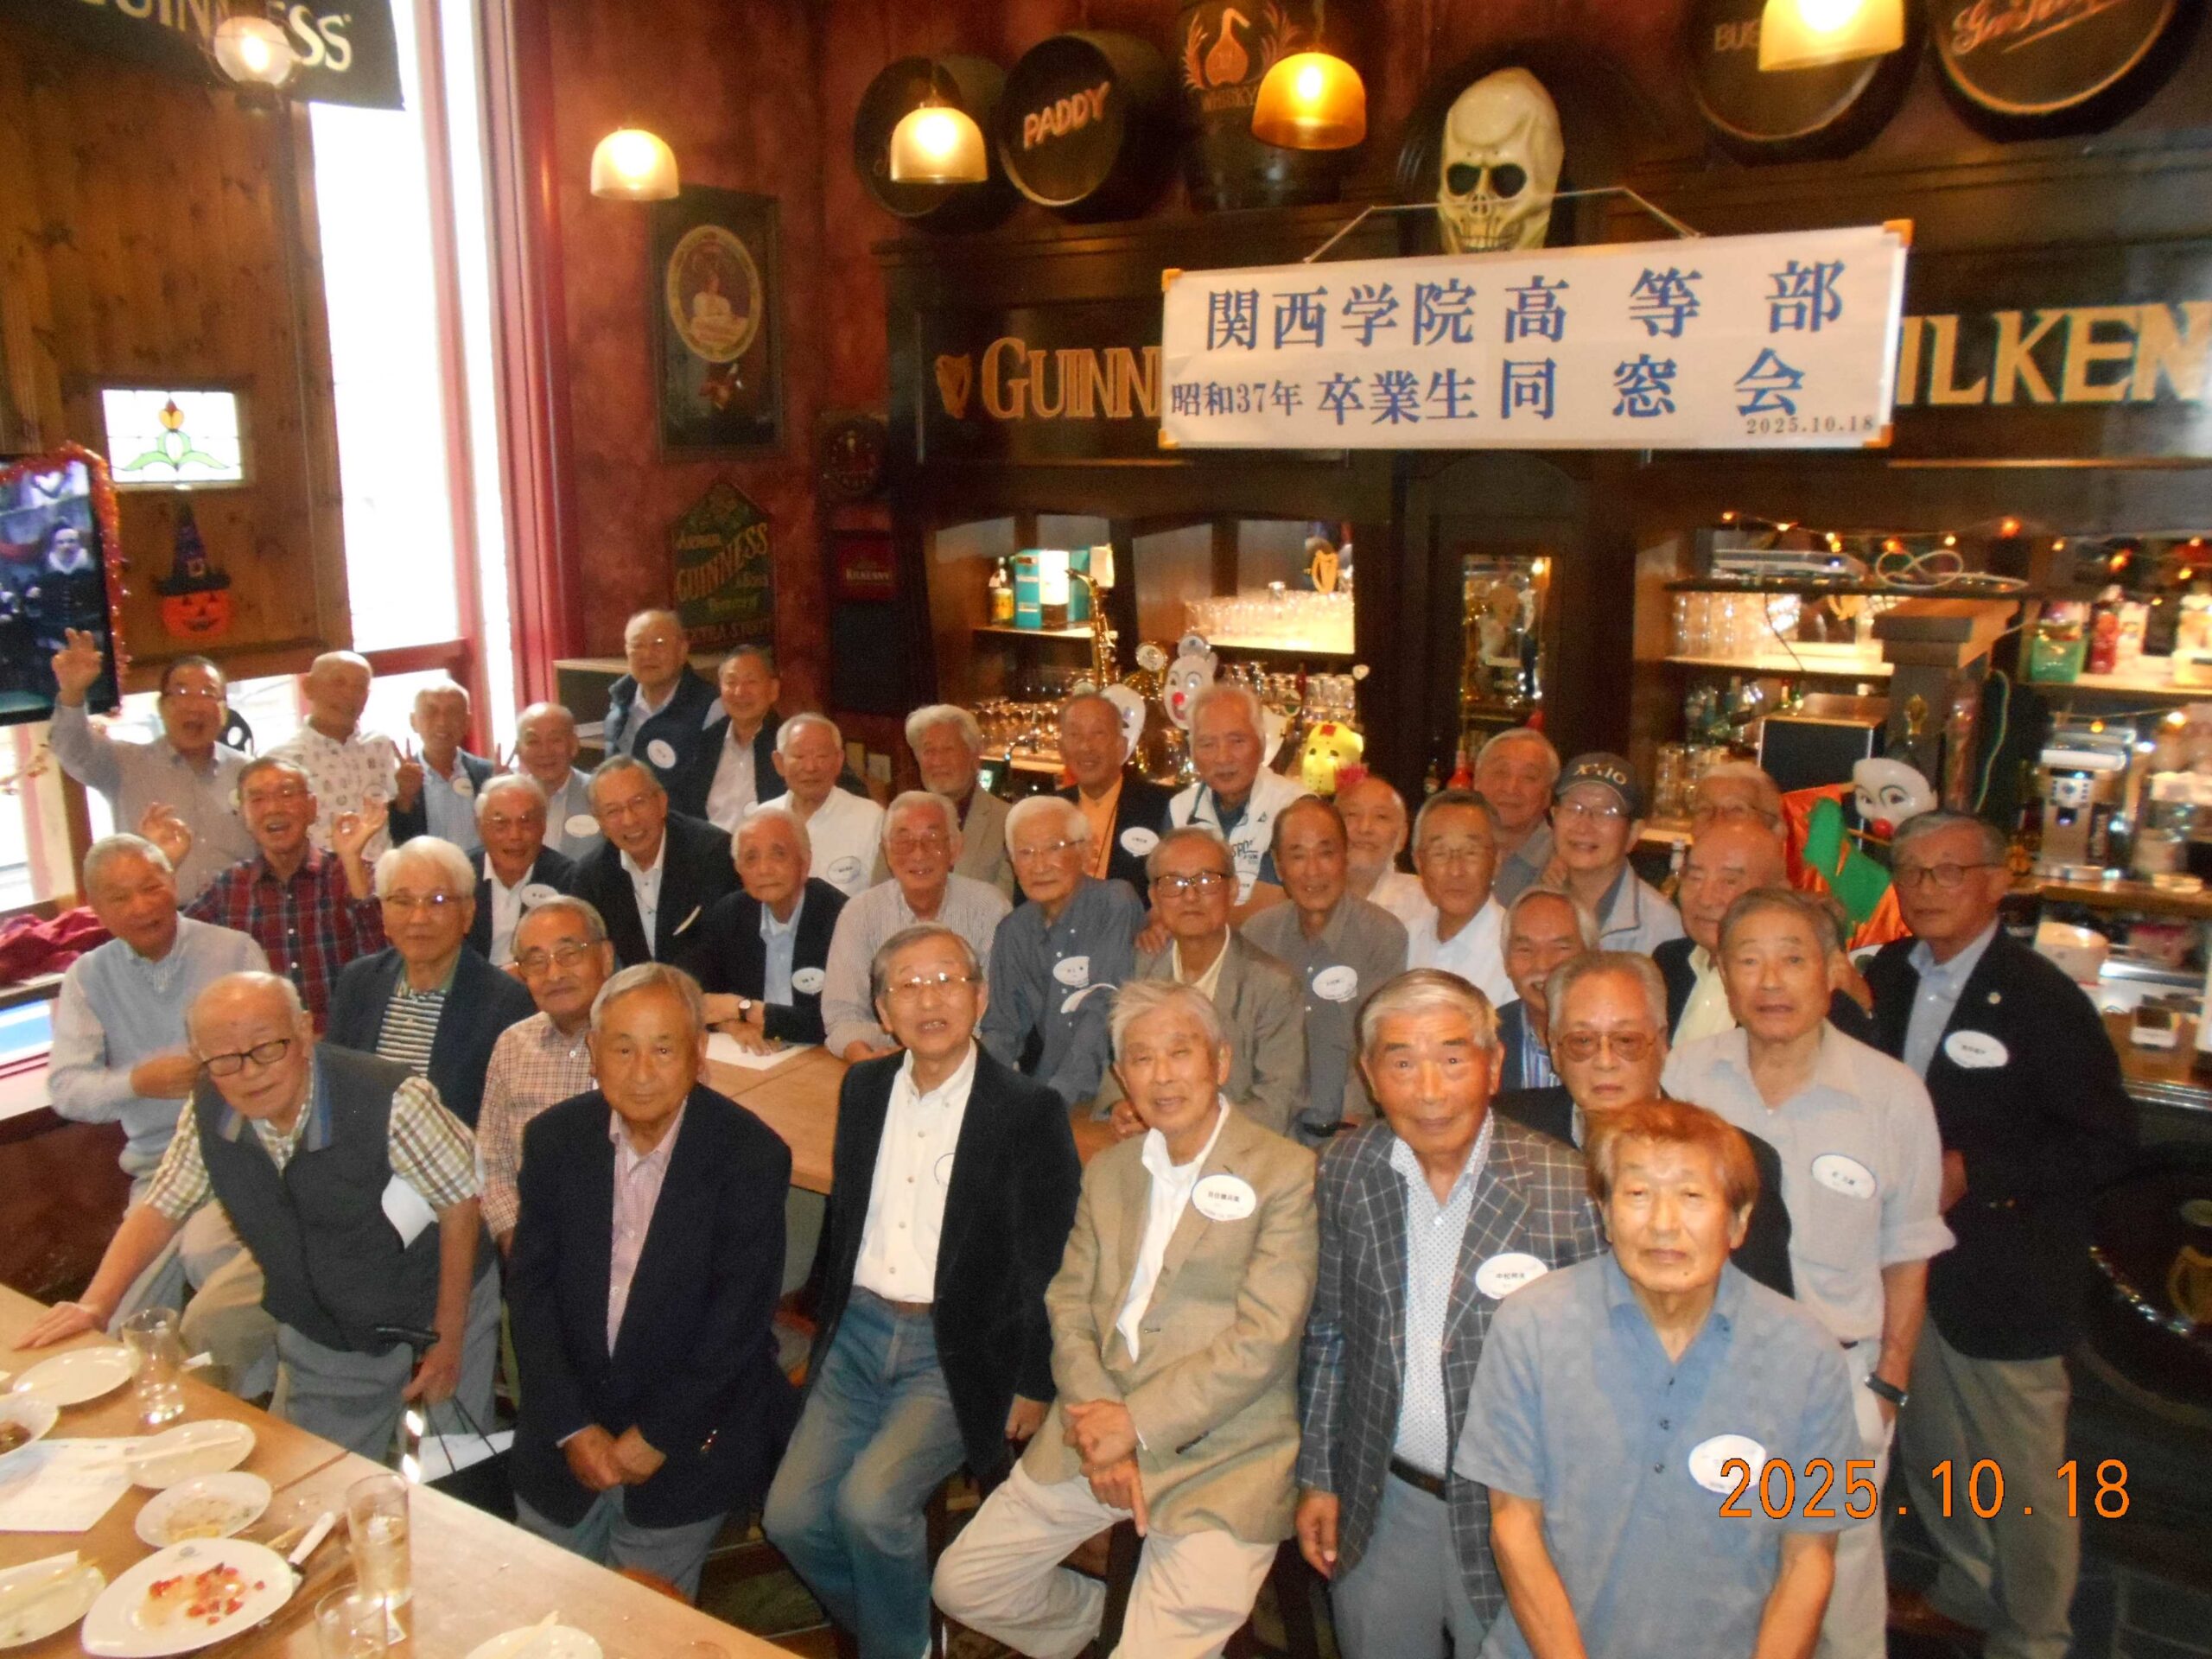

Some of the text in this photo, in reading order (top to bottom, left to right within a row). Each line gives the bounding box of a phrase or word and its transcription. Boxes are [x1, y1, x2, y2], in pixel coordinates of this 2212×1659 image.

[1023, 80, 1110, 150] PADDY
[1207, 259, 1847, 351] 関西学院高等部
[982, 337, 1161, 420] GUINN
[1746, 414, 1876, 435] 2025.10.18
